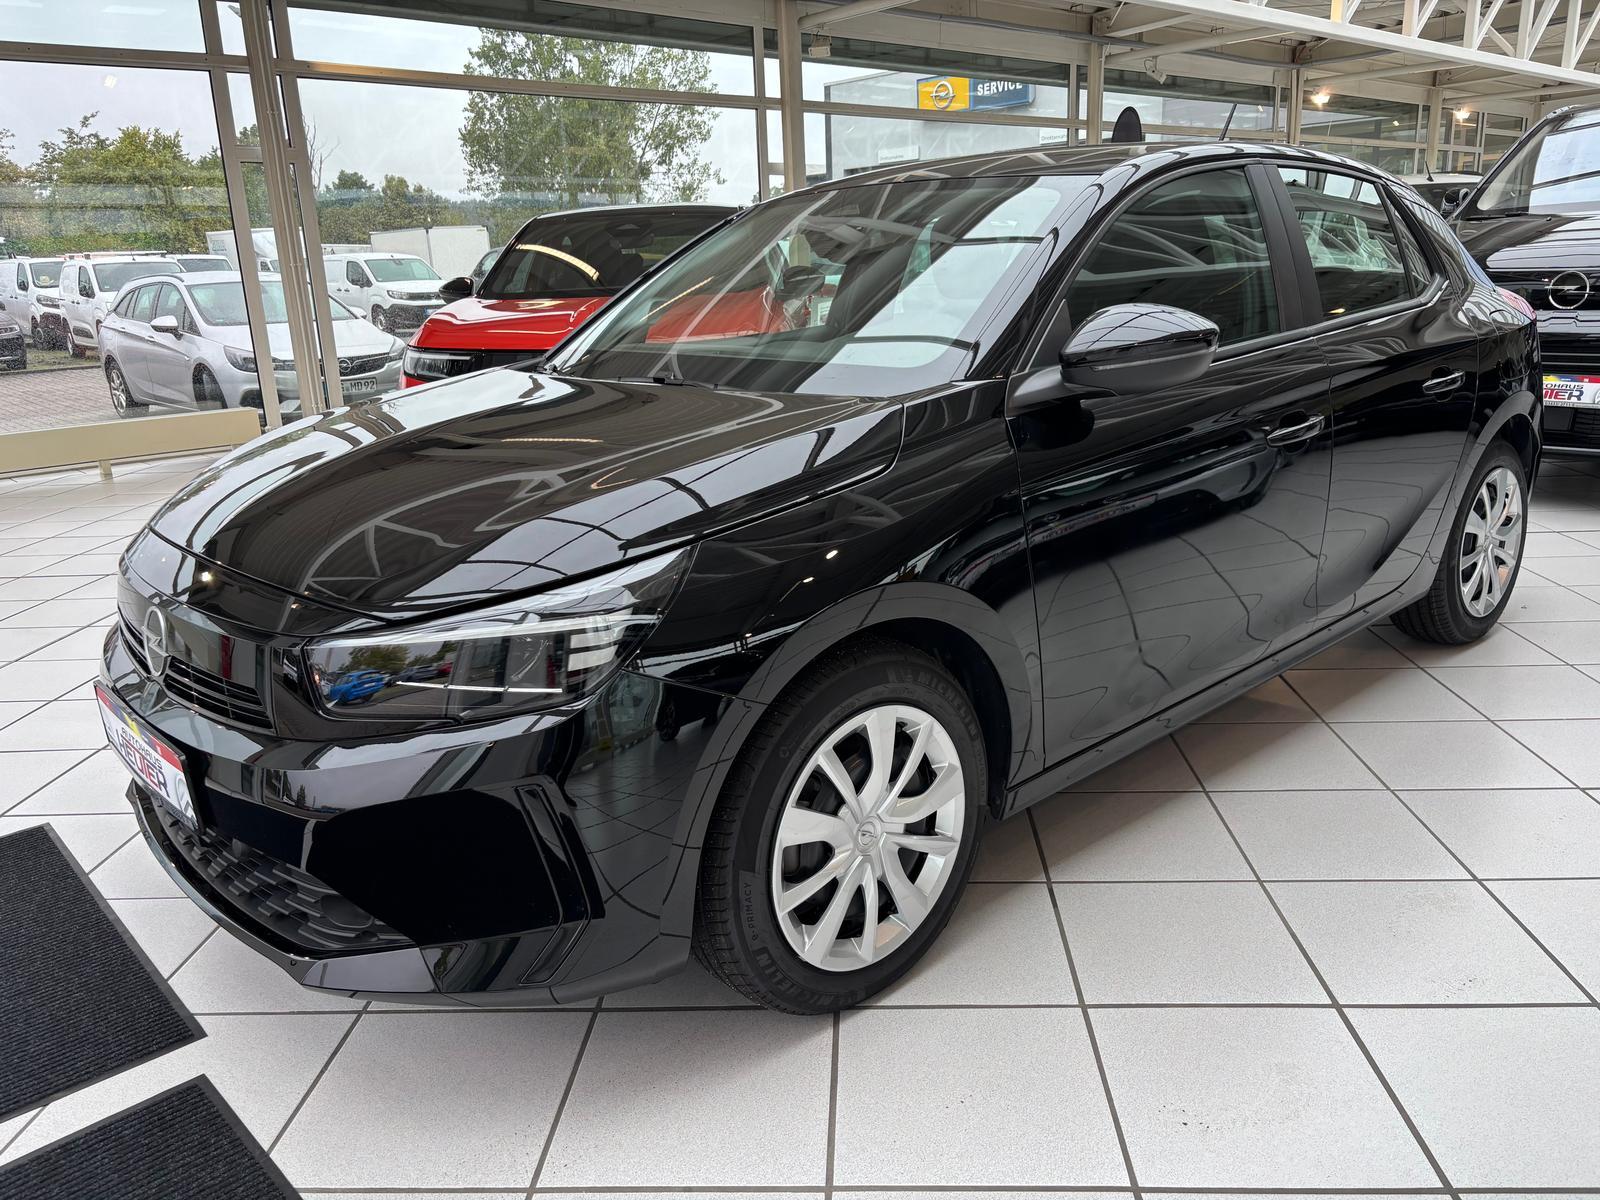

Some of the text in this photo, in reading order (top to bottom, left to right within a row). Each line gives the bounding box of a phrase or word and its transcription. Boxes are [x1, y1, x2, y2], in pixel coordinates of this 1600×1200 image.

[977, 81, 1023, 96] SERVICE
[364, 380, 375, 390] 92
[918, 670, 980, 742] MICHELIN
[120, 727, 164, 770] AUTOHAUS
